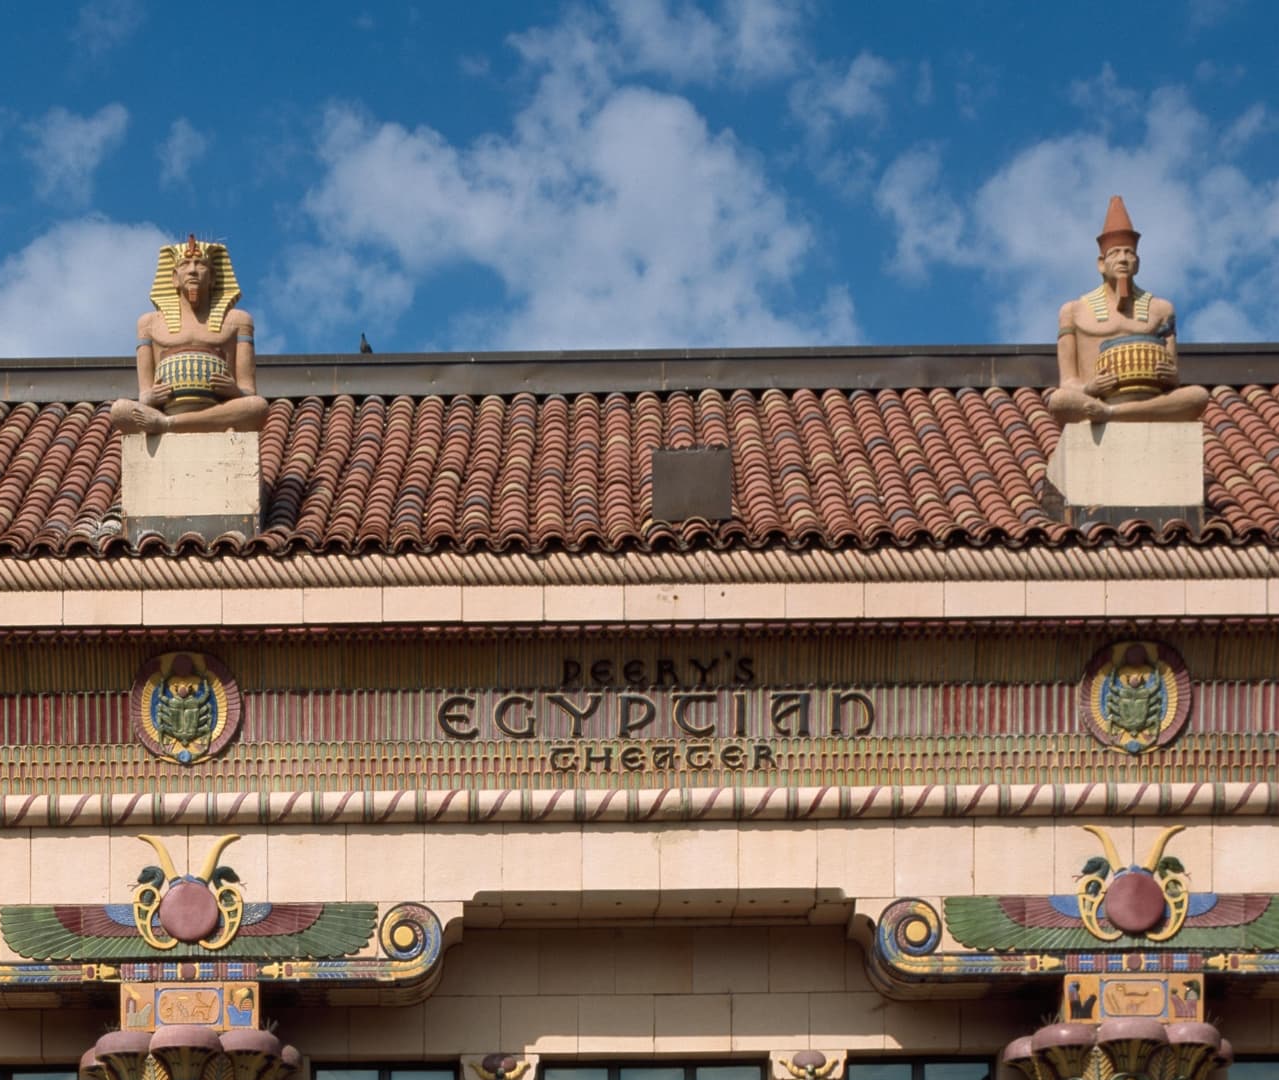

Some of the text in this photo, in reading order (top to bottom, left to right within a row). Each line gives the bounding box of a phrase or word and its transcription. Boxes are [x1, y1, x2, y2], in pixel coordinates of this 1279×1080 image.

[562, 652, 755, 686] PEERY'S
[437, 690, 876, 740] EGYPTIAN
[549, 744, 777, 772] THEATER
